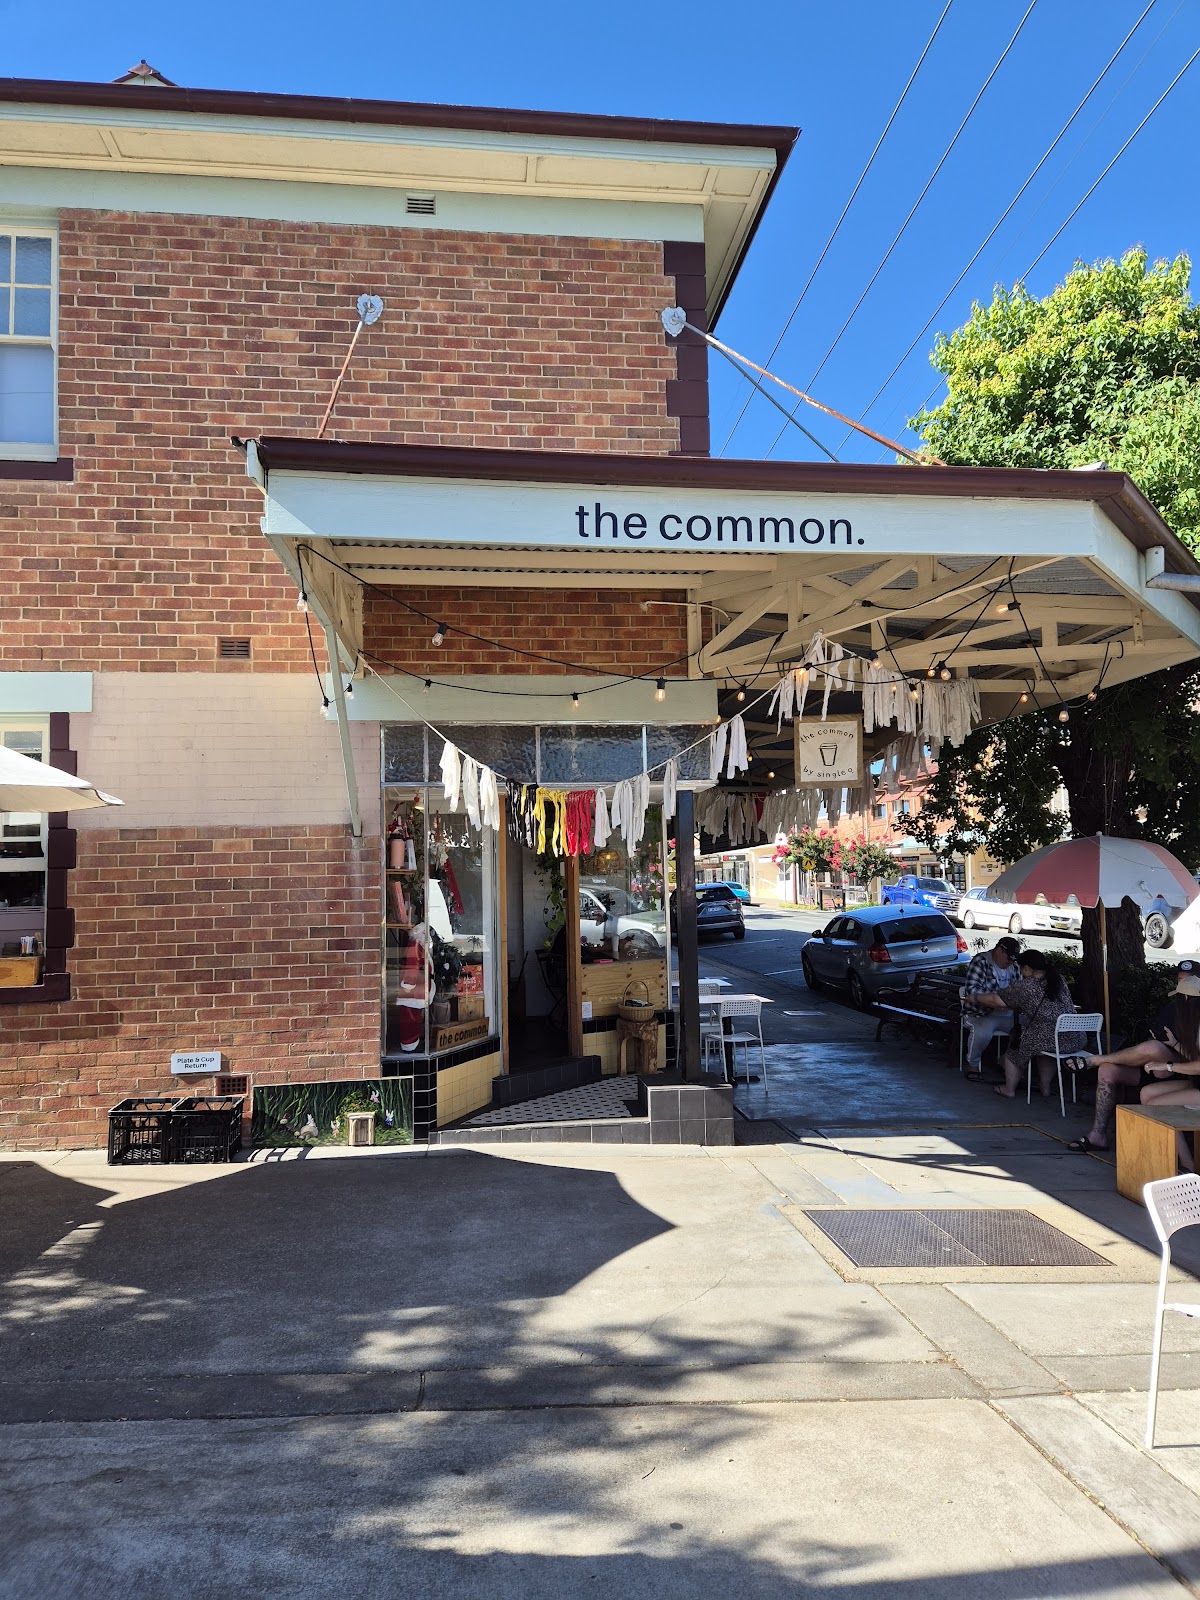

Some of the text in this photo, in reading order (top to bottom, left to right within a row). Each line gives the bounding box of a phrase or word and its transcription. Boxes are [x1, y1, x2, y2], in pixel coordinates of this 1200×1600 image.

[575, 502, 865, 546] the common.
[799, 728, 854, 743] the common
[802, 765, 814, 776] by
[816, 769, 847, 779] single
[440, 1034, 452, 1047] the
